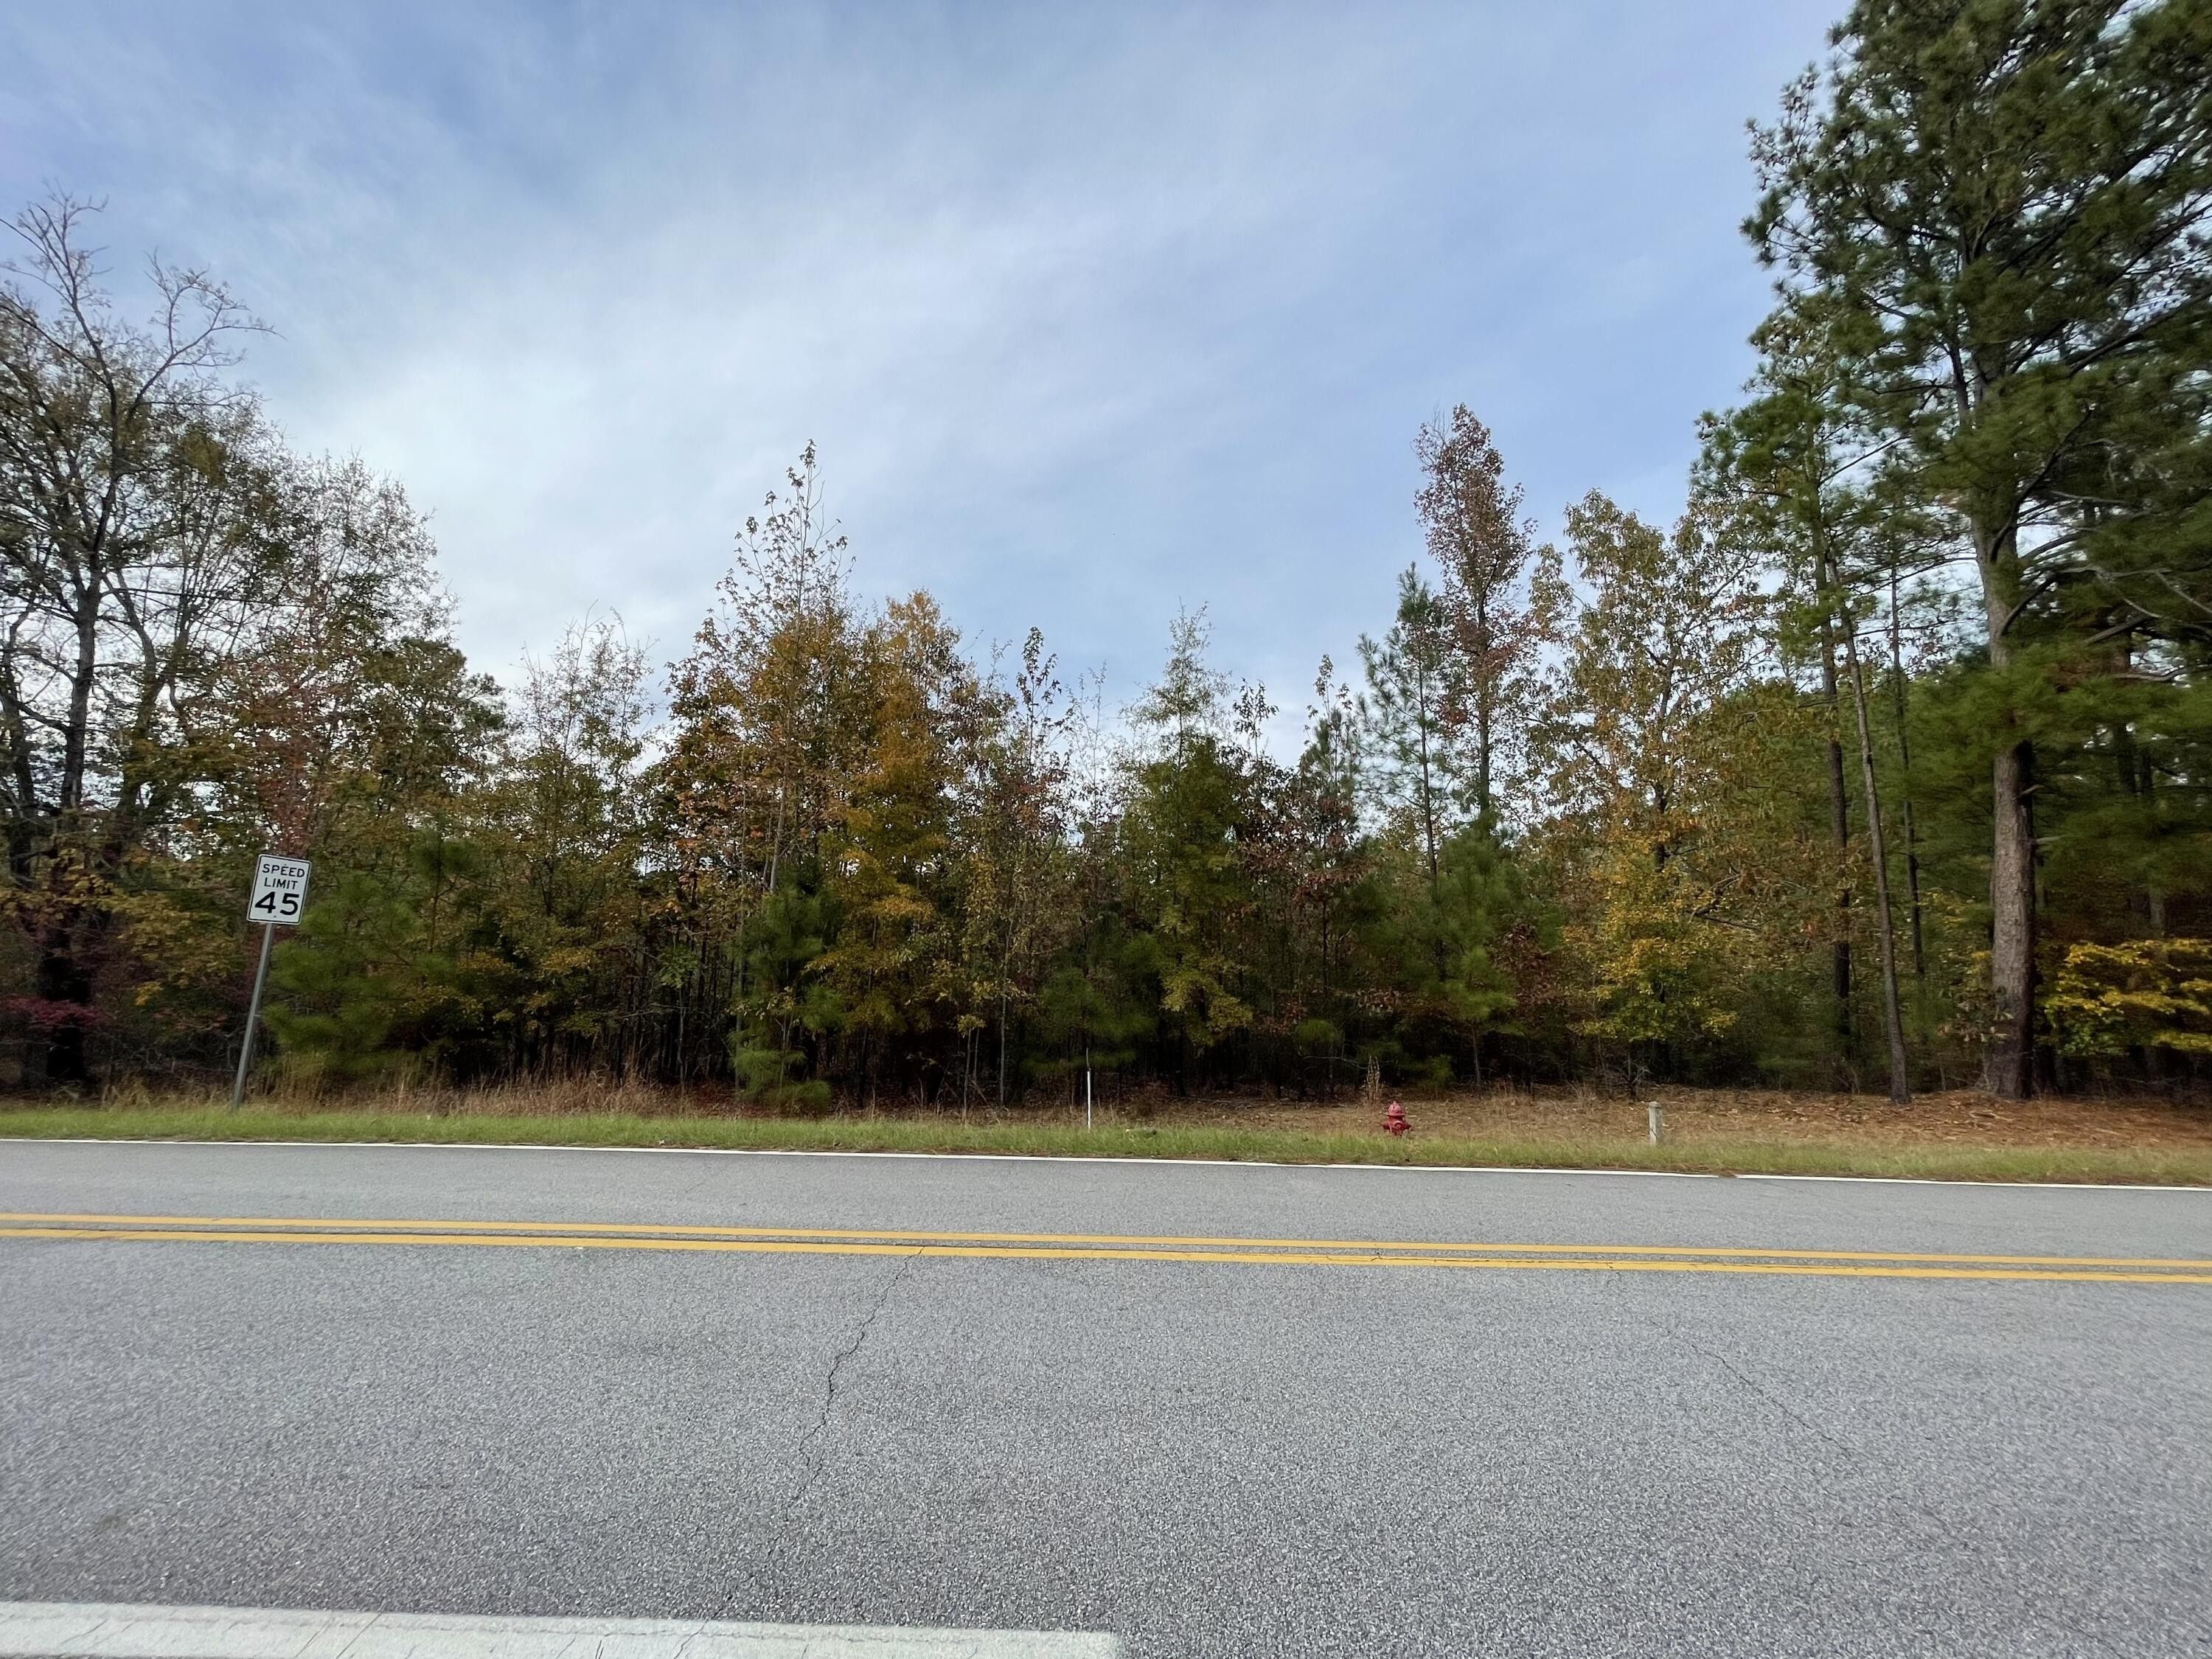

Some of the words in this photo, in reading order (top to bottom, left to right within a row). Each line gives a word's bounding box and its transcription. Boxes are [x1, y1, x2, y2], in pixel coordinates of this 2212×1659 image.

[262, 863, 305, 877] SPEED
[264, 877, 299, 890] LIMIT
[254, 891, 299, 916] 45
